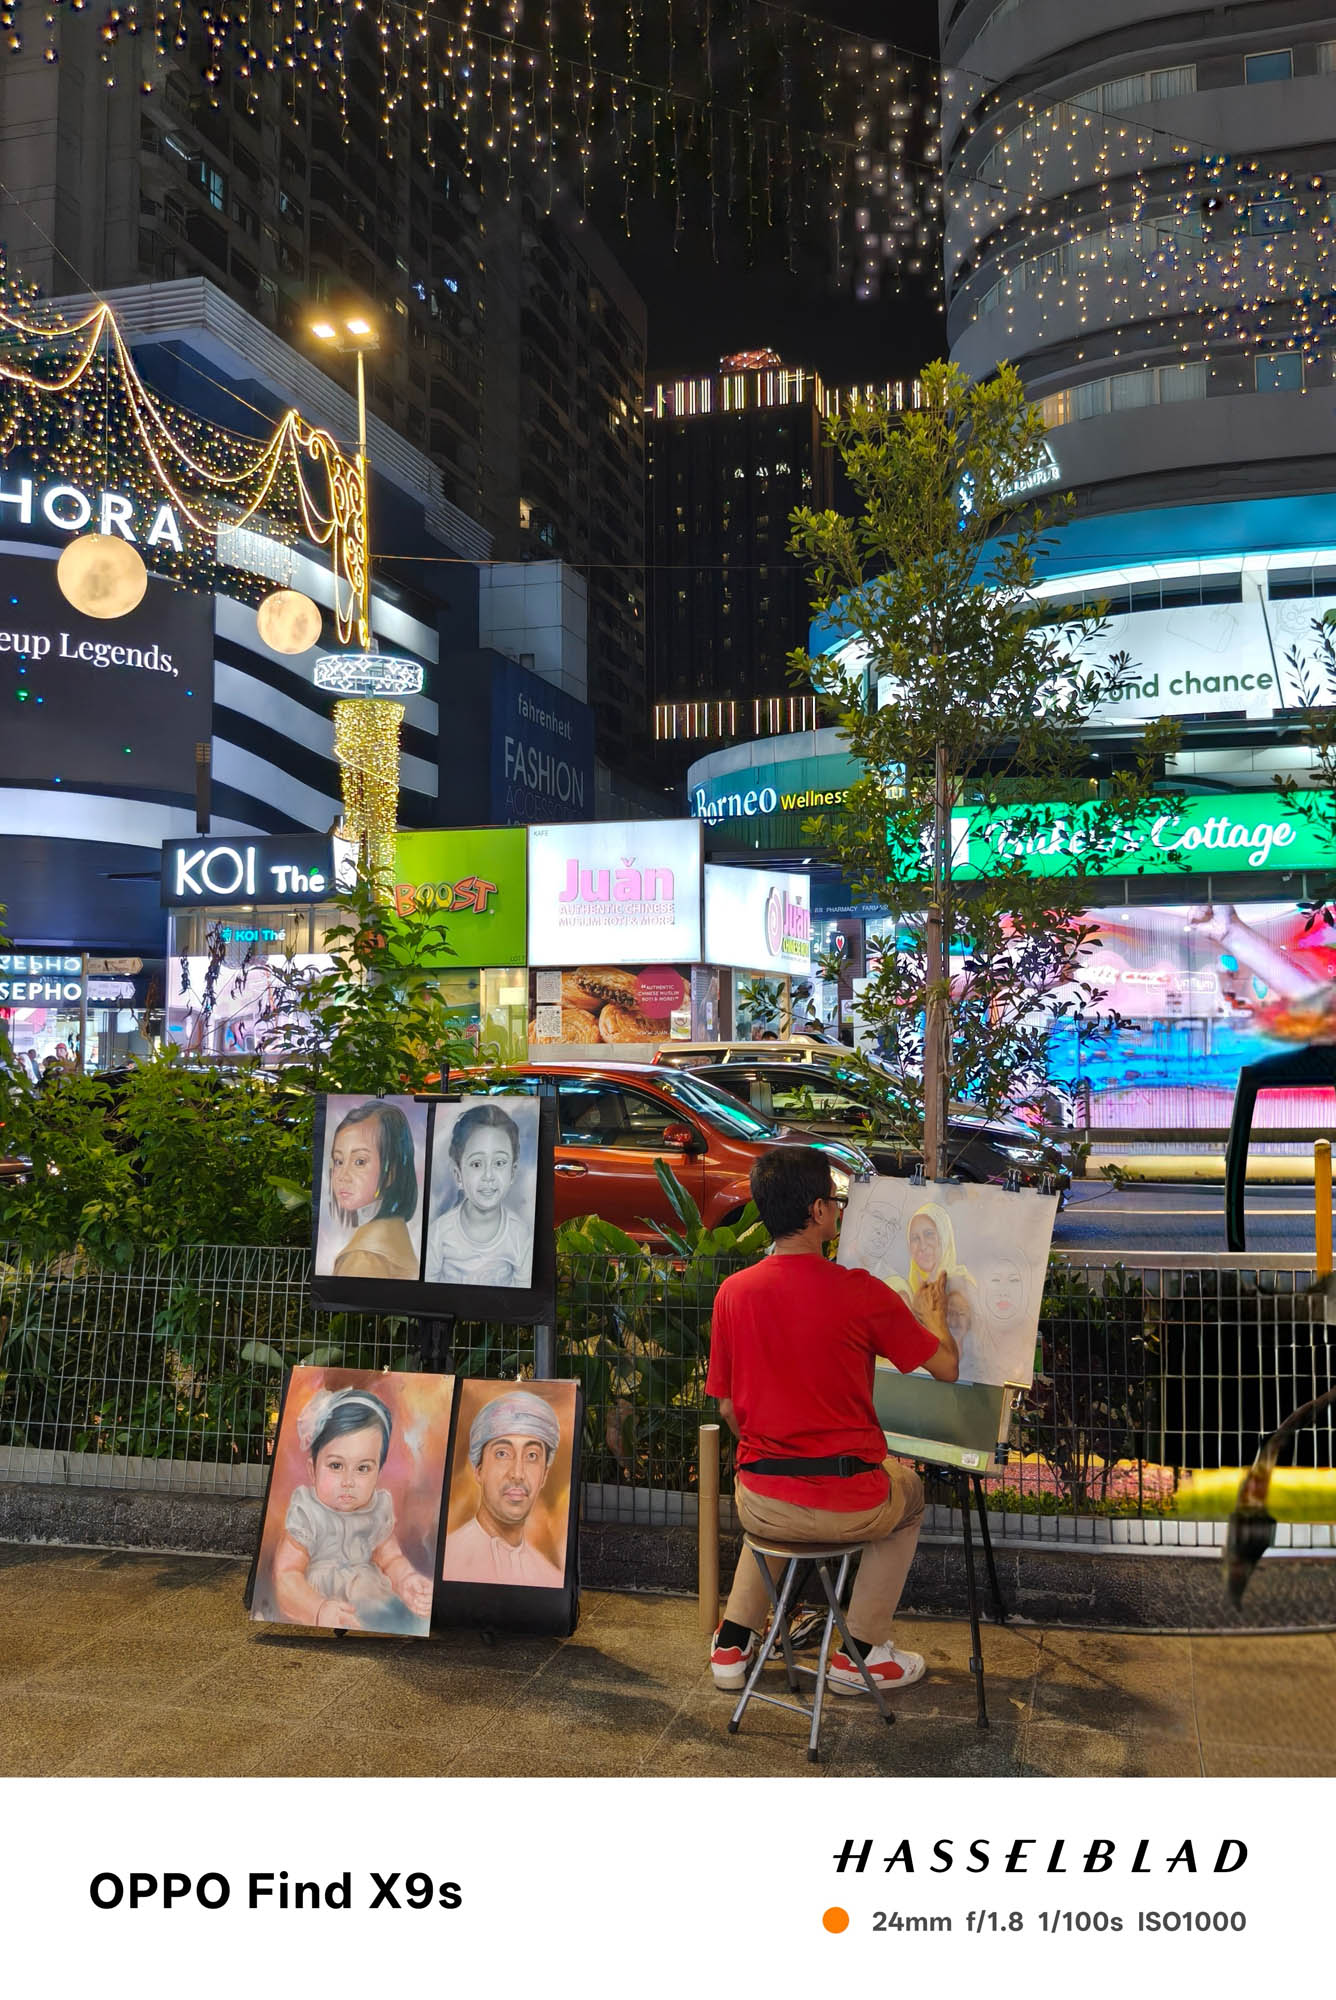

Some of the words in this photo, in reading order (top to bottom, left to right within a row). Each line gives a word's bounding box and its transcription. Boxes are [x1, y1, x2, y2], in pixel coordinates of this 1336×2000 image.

[0, 478, 183, 552] HORA
[0, 631, 50, 660] eup
[59, 632, 180, 678] Legends,
[1169, 670, 1273, 696] chance
[518, 692, 572, 741] fahrenheit
[504, 735, 584, 808] FASHION
[696, 787, 777, 826] Borneo
[780, 790, 850, 811] Wellness
[1151, 814, 1297, 867] Cottage
[174, 846, 257, 896] KOI
[270, 866, 325, 894] Thé
[394, 876, 498, 918] BOOST
[559, 903, 624, 915] AUTHENTIC
[626, 903, 675, 914] CHINESE
[826, 905, 858, 913] PHARMACY
[234, 929, 259, 941] KOI
[262, 928, 286, 941] Thé
